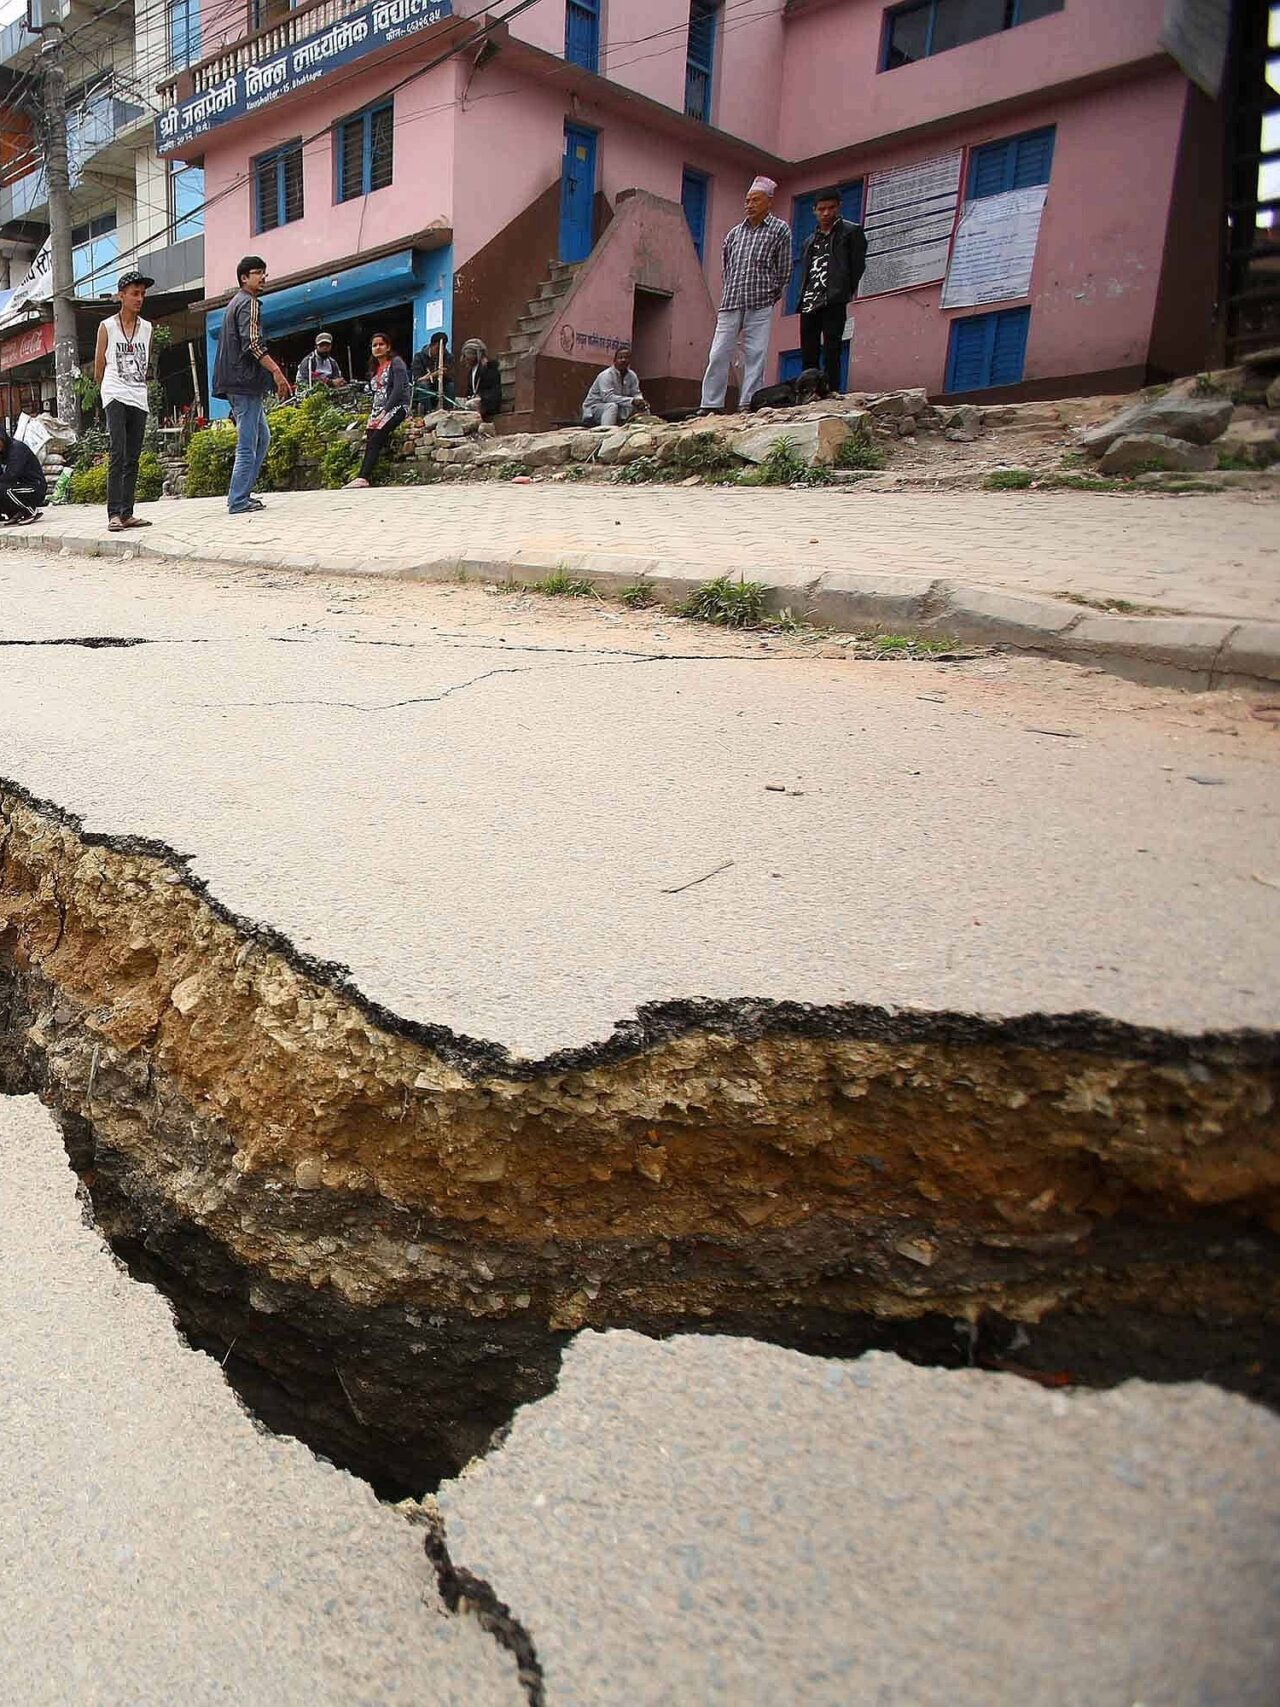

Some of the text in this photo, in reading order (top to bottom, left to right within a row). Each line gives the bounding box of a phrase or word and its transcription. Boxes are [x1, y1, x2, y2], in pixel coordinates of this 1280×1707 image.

[160, 0, 446, 139] श्री जनप्रेमी निम्न माध्यमिक विद्याल
